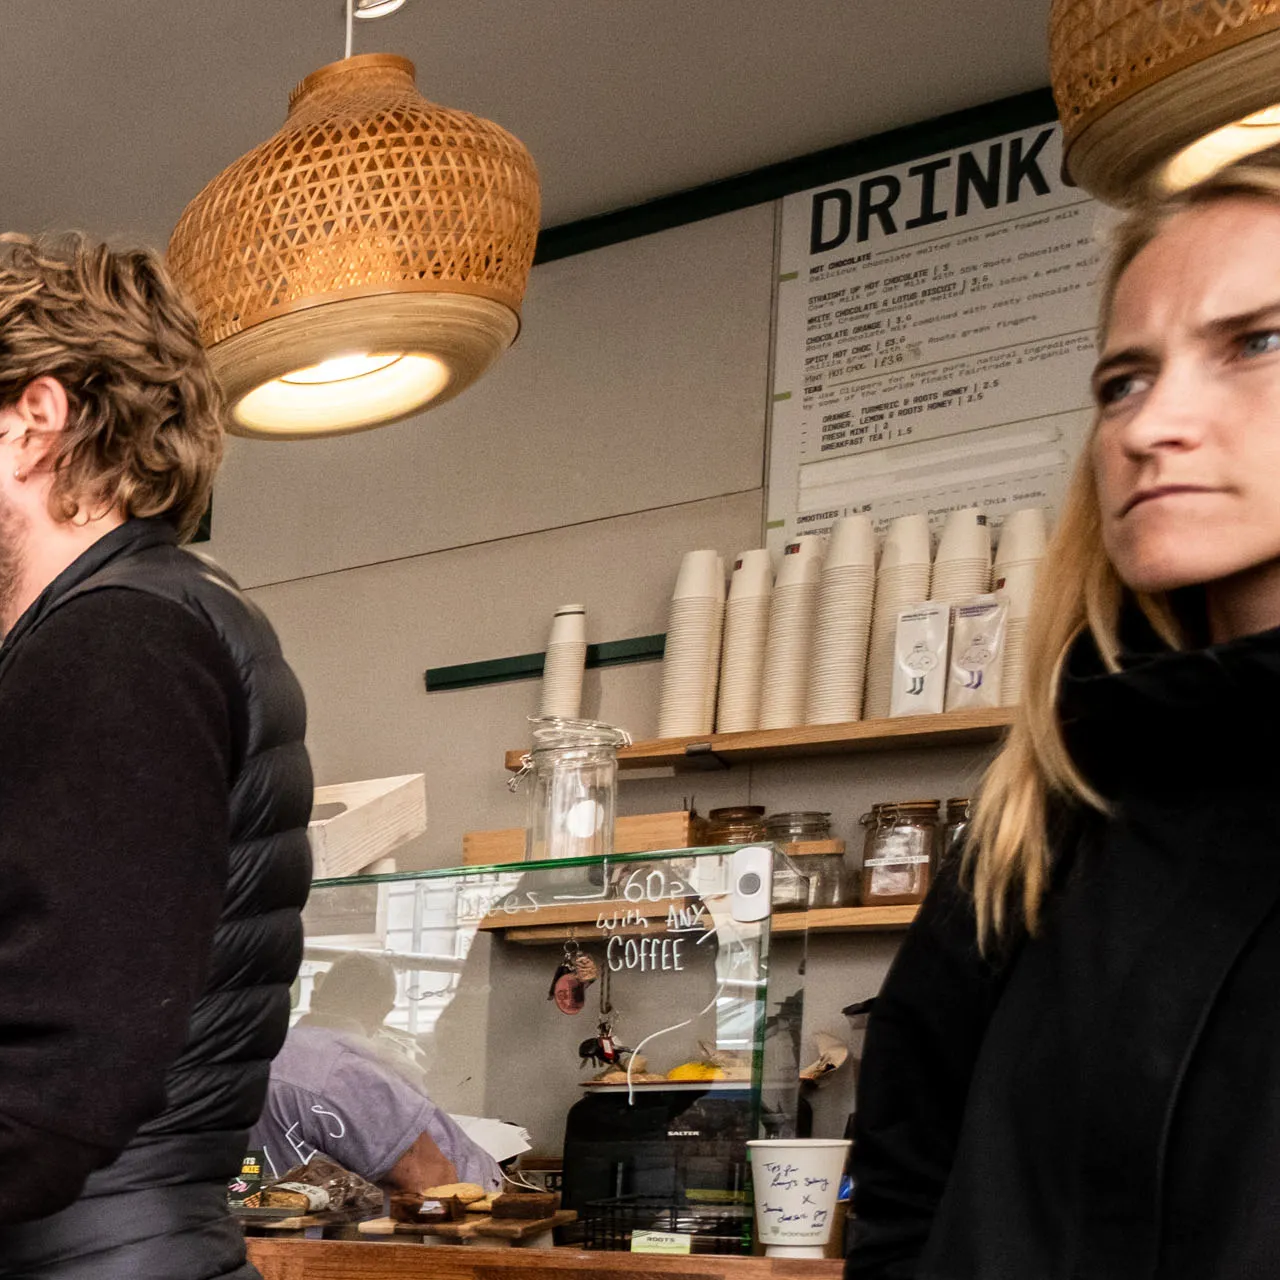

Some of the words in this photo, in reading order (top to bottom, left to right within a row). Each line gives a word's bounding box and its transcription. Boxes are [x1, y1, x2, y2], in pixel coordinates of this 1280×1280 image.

[809, 127, 1077, 256] DRINK
[862, 251, 911, 269] chocolate
[916, 241, 950, 255] melted
[957, 233, 978, 245] into
[1014, 216, 1049, 231] foamed
[1054, 208, 1078, 221] milk
[809, 264, 823, 274] HOT
[828, 252, 871, 270] CHOCOLATE
[932, 270, 953, 281] with
[1018, 241, 1070, 260] Chocolate
[808, 288, 845, 305] STRAIGHT
[850, 284, 860, 294] UP
[864, 280, 880, 291] HOT
[883, 268, 928, 286] CHOCOLATE
[807, 312, 830, 324] WHITE
[835, 301, 877, 318] CHOCOLATE
[892, 291, 917, 304] LOTUS
[921, 282, 956, 297] BISCUIT
[837, 328, 885, 344] chocolate
[962, 303, 986, 315] with
[1027, 281, 1080, 300] chocolate
[875, 298, 924, 315] chocolate
[805, 328, 848, 345] CHOCOLATE
[852, 320, 881, 334] ORANGE
[928, 331, 955, 344] Roots
[996, 313, 1036, 330] fingers
[804, 353, 828, 365] SPICY
[832, 349, 847, 358] HOT
[851, 343, 871, 354] CHOC
[804, 384, 821, 394] TEAS
[888, 375, 904, 384] for
[859, 413, 883, 424] LEMON
[897, 405, 922, 416] ROOTS
[927, 398, 952, 410] HONEY
[861, 400, 898, 414] TURMERIC
[913, 391, 937, 404] ROOTS
[942, 385, 967, 397] HONEY
[821, 436, 864, 451] BREAKFAST
[869, 432, 883, 442] TEA
[822, 430, 845, 441] FRESH
[850, 426, 868, 435] MINT
[796, 509, 838, 524] SMOOTHIES
[666, 904, 706, 930] ANY
